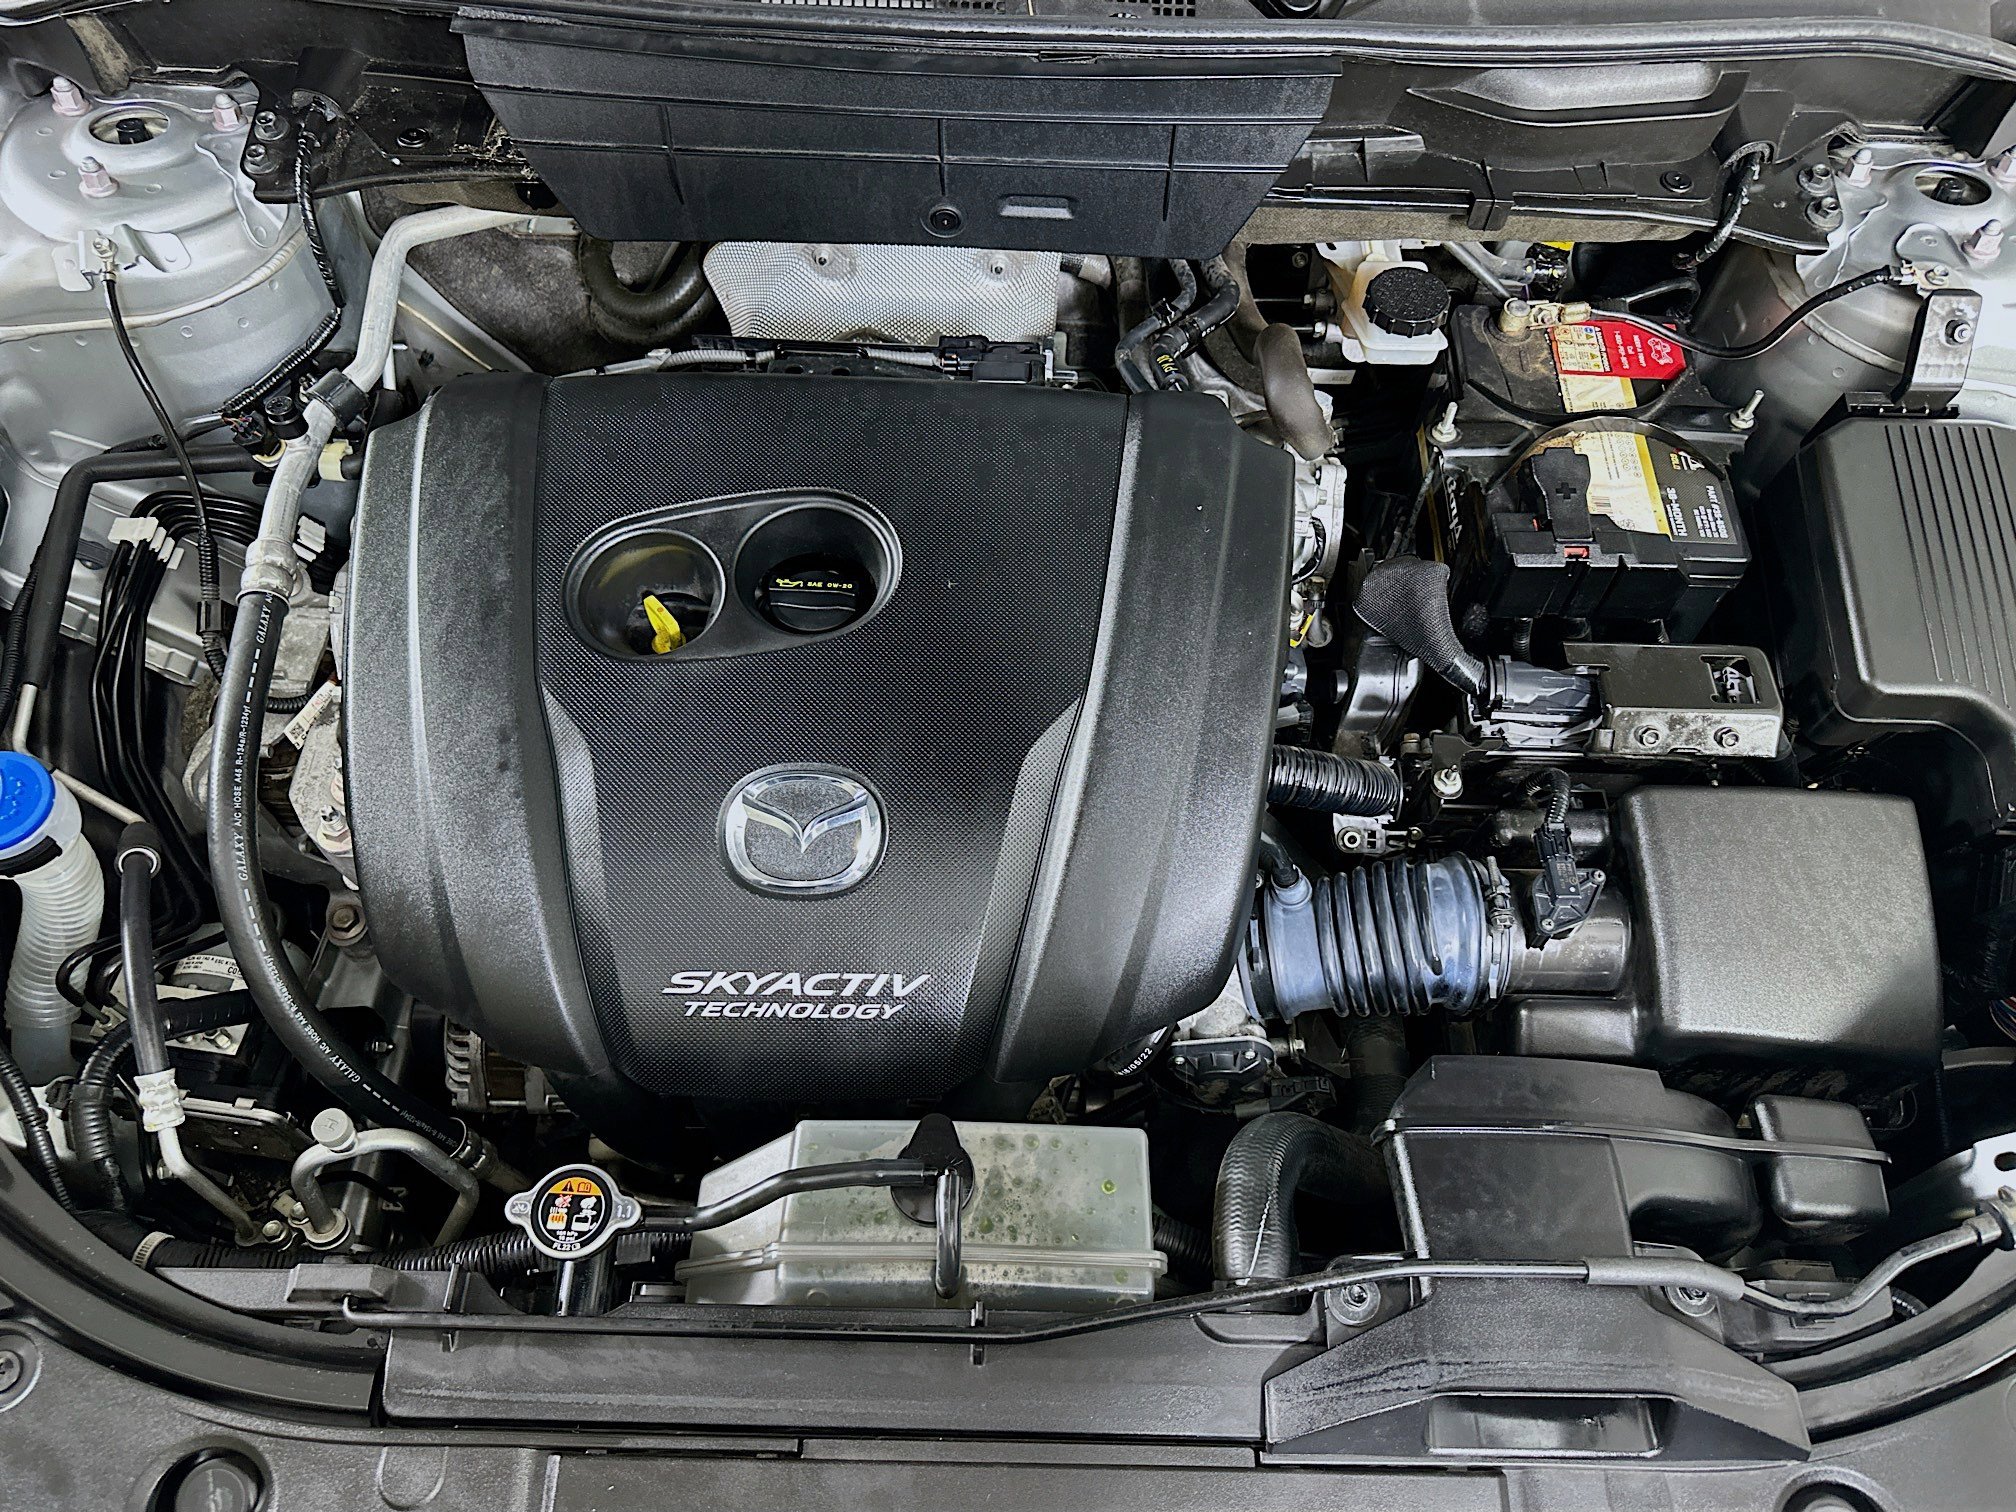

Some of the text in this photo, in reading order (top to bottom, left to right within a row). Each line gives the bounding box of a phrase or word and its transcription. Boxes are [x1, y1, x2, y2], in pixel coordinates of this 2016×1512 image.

[1706, 486, 1719, 503] PART
[256, 605, 271, 644] GALAXY
[234, 786, 242, 811] HOSE
[234, 811, 242, 827] A/C
[234, 832, 248, 881] GALAXY
[662, 971, 931, 997] SKYACTIV
[684, 1001, 905, 1019] TECHNOLOGY
[305, 1025, 321, 1043] HOSE
[320, 1042, 331, 1054] A/C
[329, 1055, 360, 1083] GALAXY
[617, 1205, 631, 1218] 1.1
[552, 1243, 571, 1251] FL22
